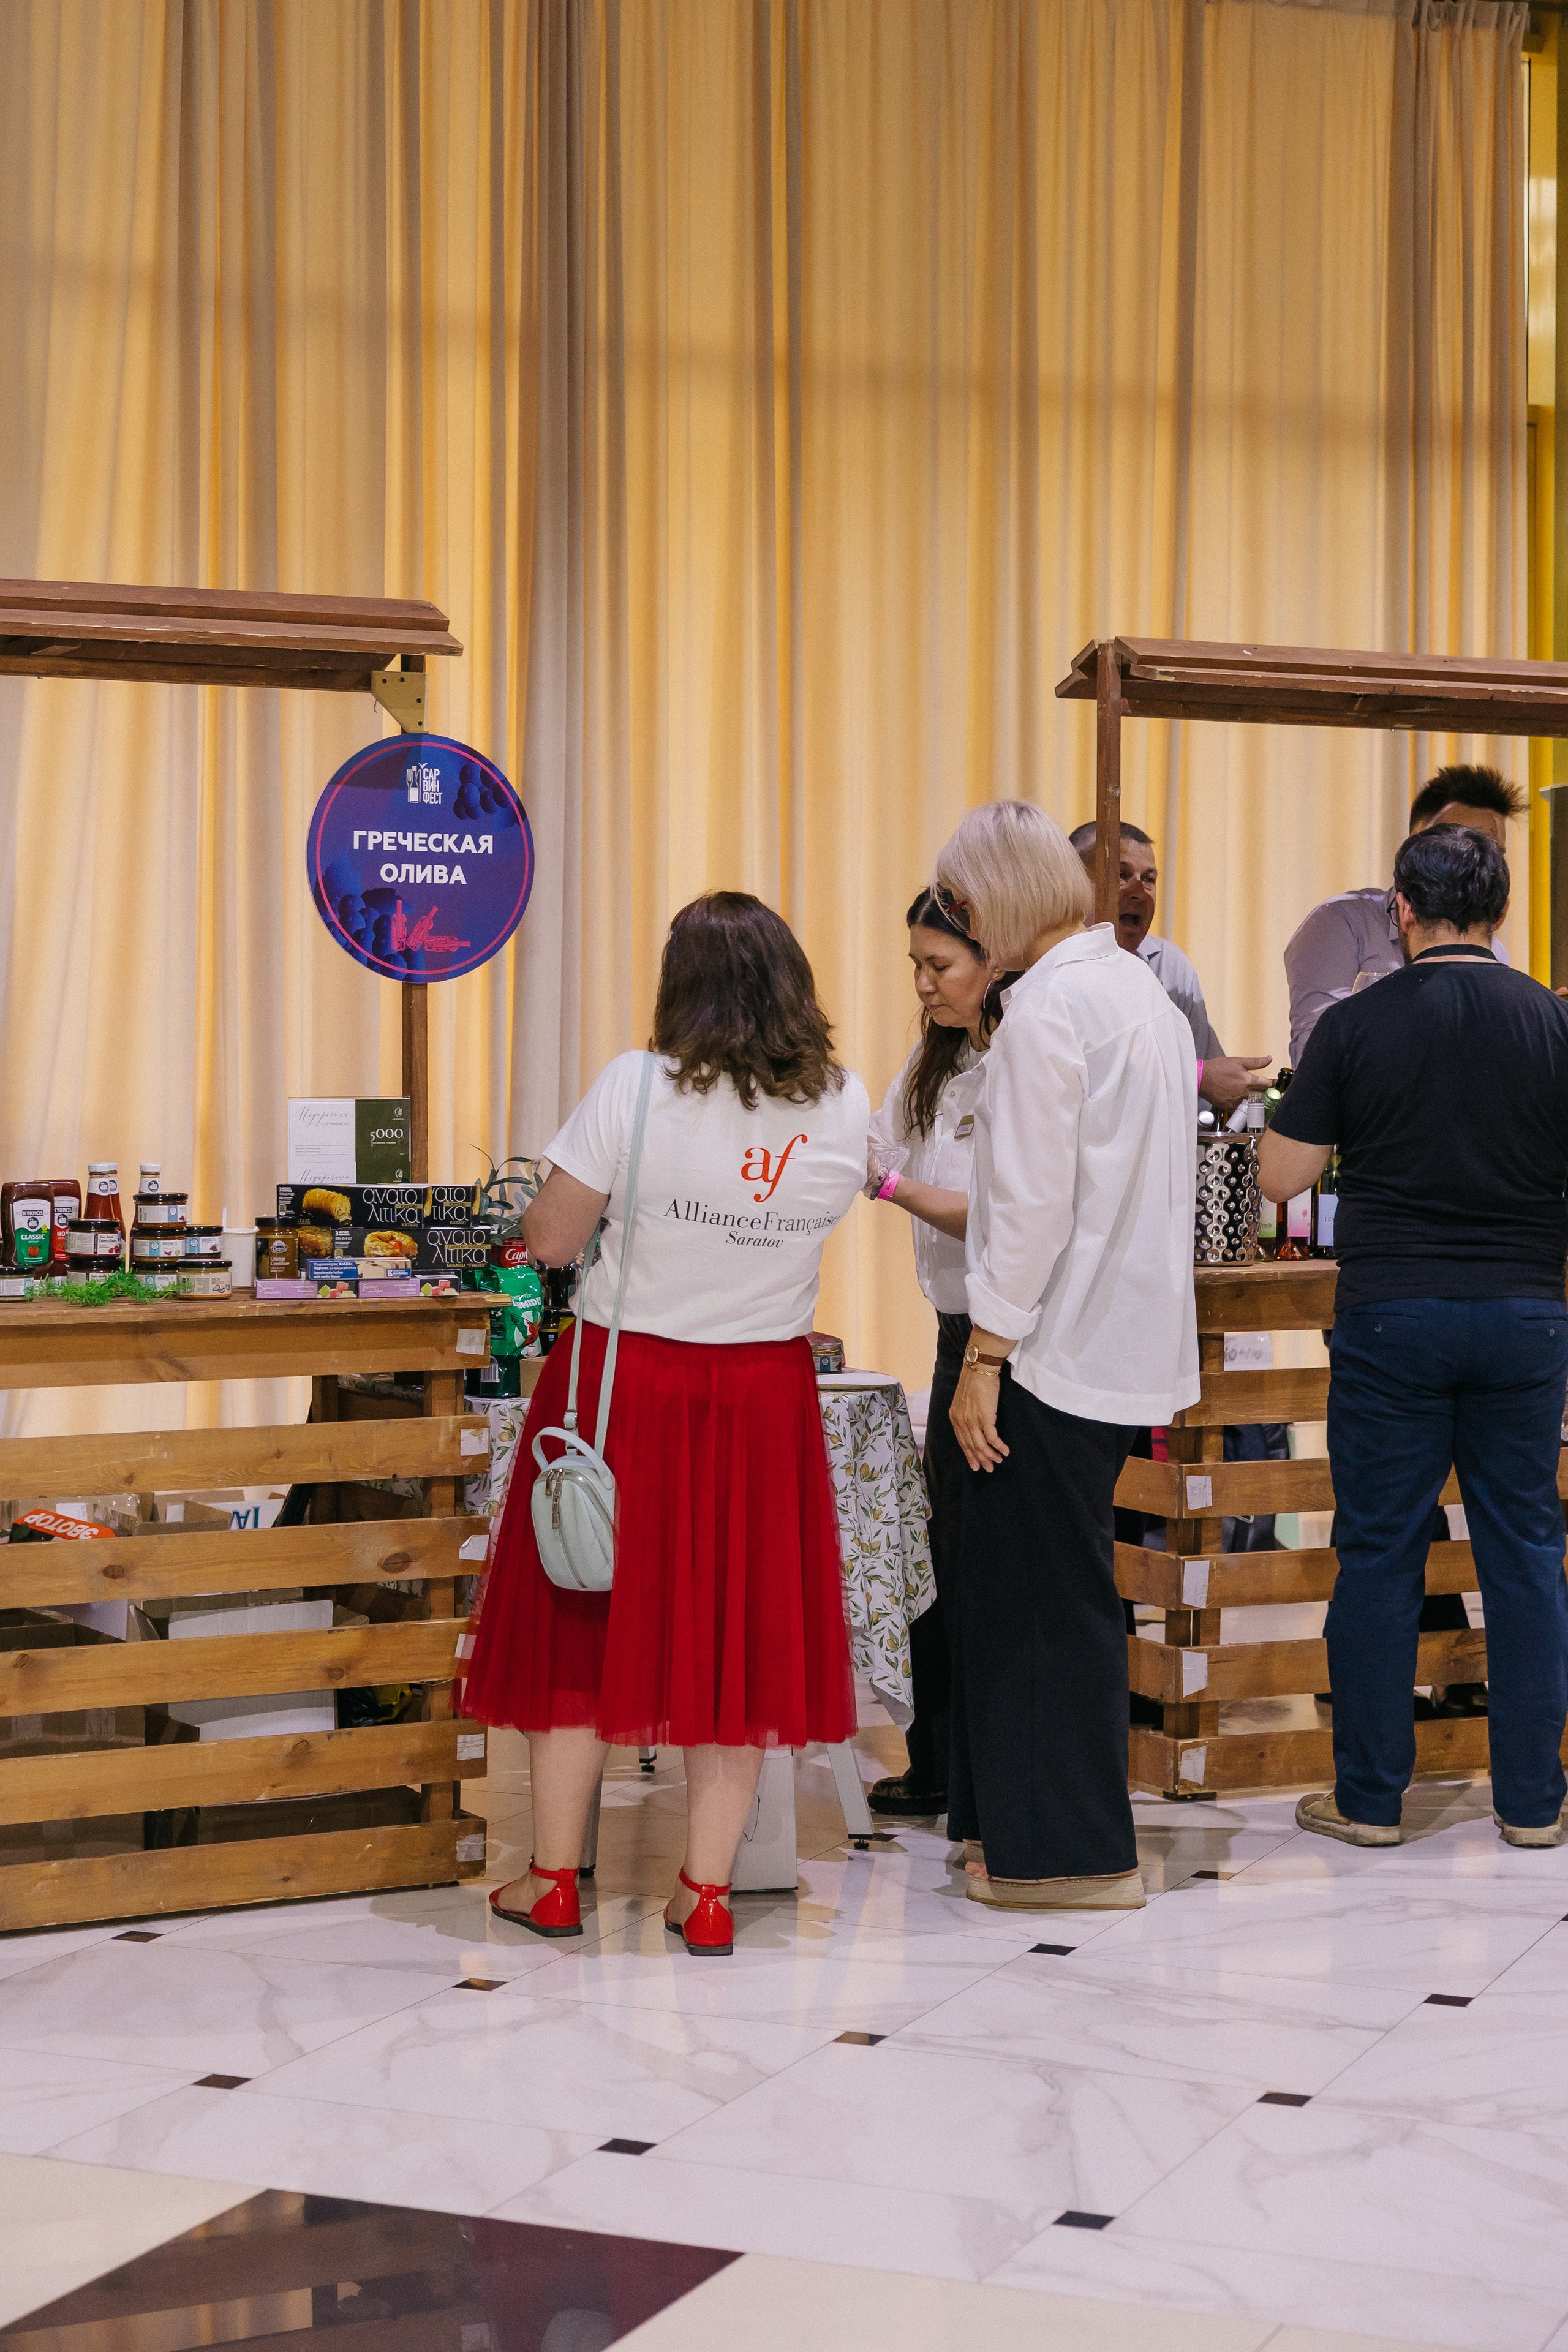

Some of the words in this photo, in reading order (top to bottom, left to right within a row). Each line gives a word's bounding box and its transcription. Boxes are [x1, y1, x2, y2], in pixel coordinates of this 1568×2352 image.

[423, 768, 440, 780] САР
[423, 780, 440, 793] ВИН
[423, 791, 443, 804] ФЕСТ
[353, 830, 494, 854] ГРЕЧЕСКАЯ
[380, 862, 467, 885] ОЛИВА
[370, 1128, 404, 1142] 5000
[741, 1134, 808, 1203] af
[432, 1187, 466, 1202] ατο
[432, 1205, 469, 1221] τικα
[725, 1231, 783, 1248] Saratov
[24, 1512, 99, 1540] ЭВОТОР
